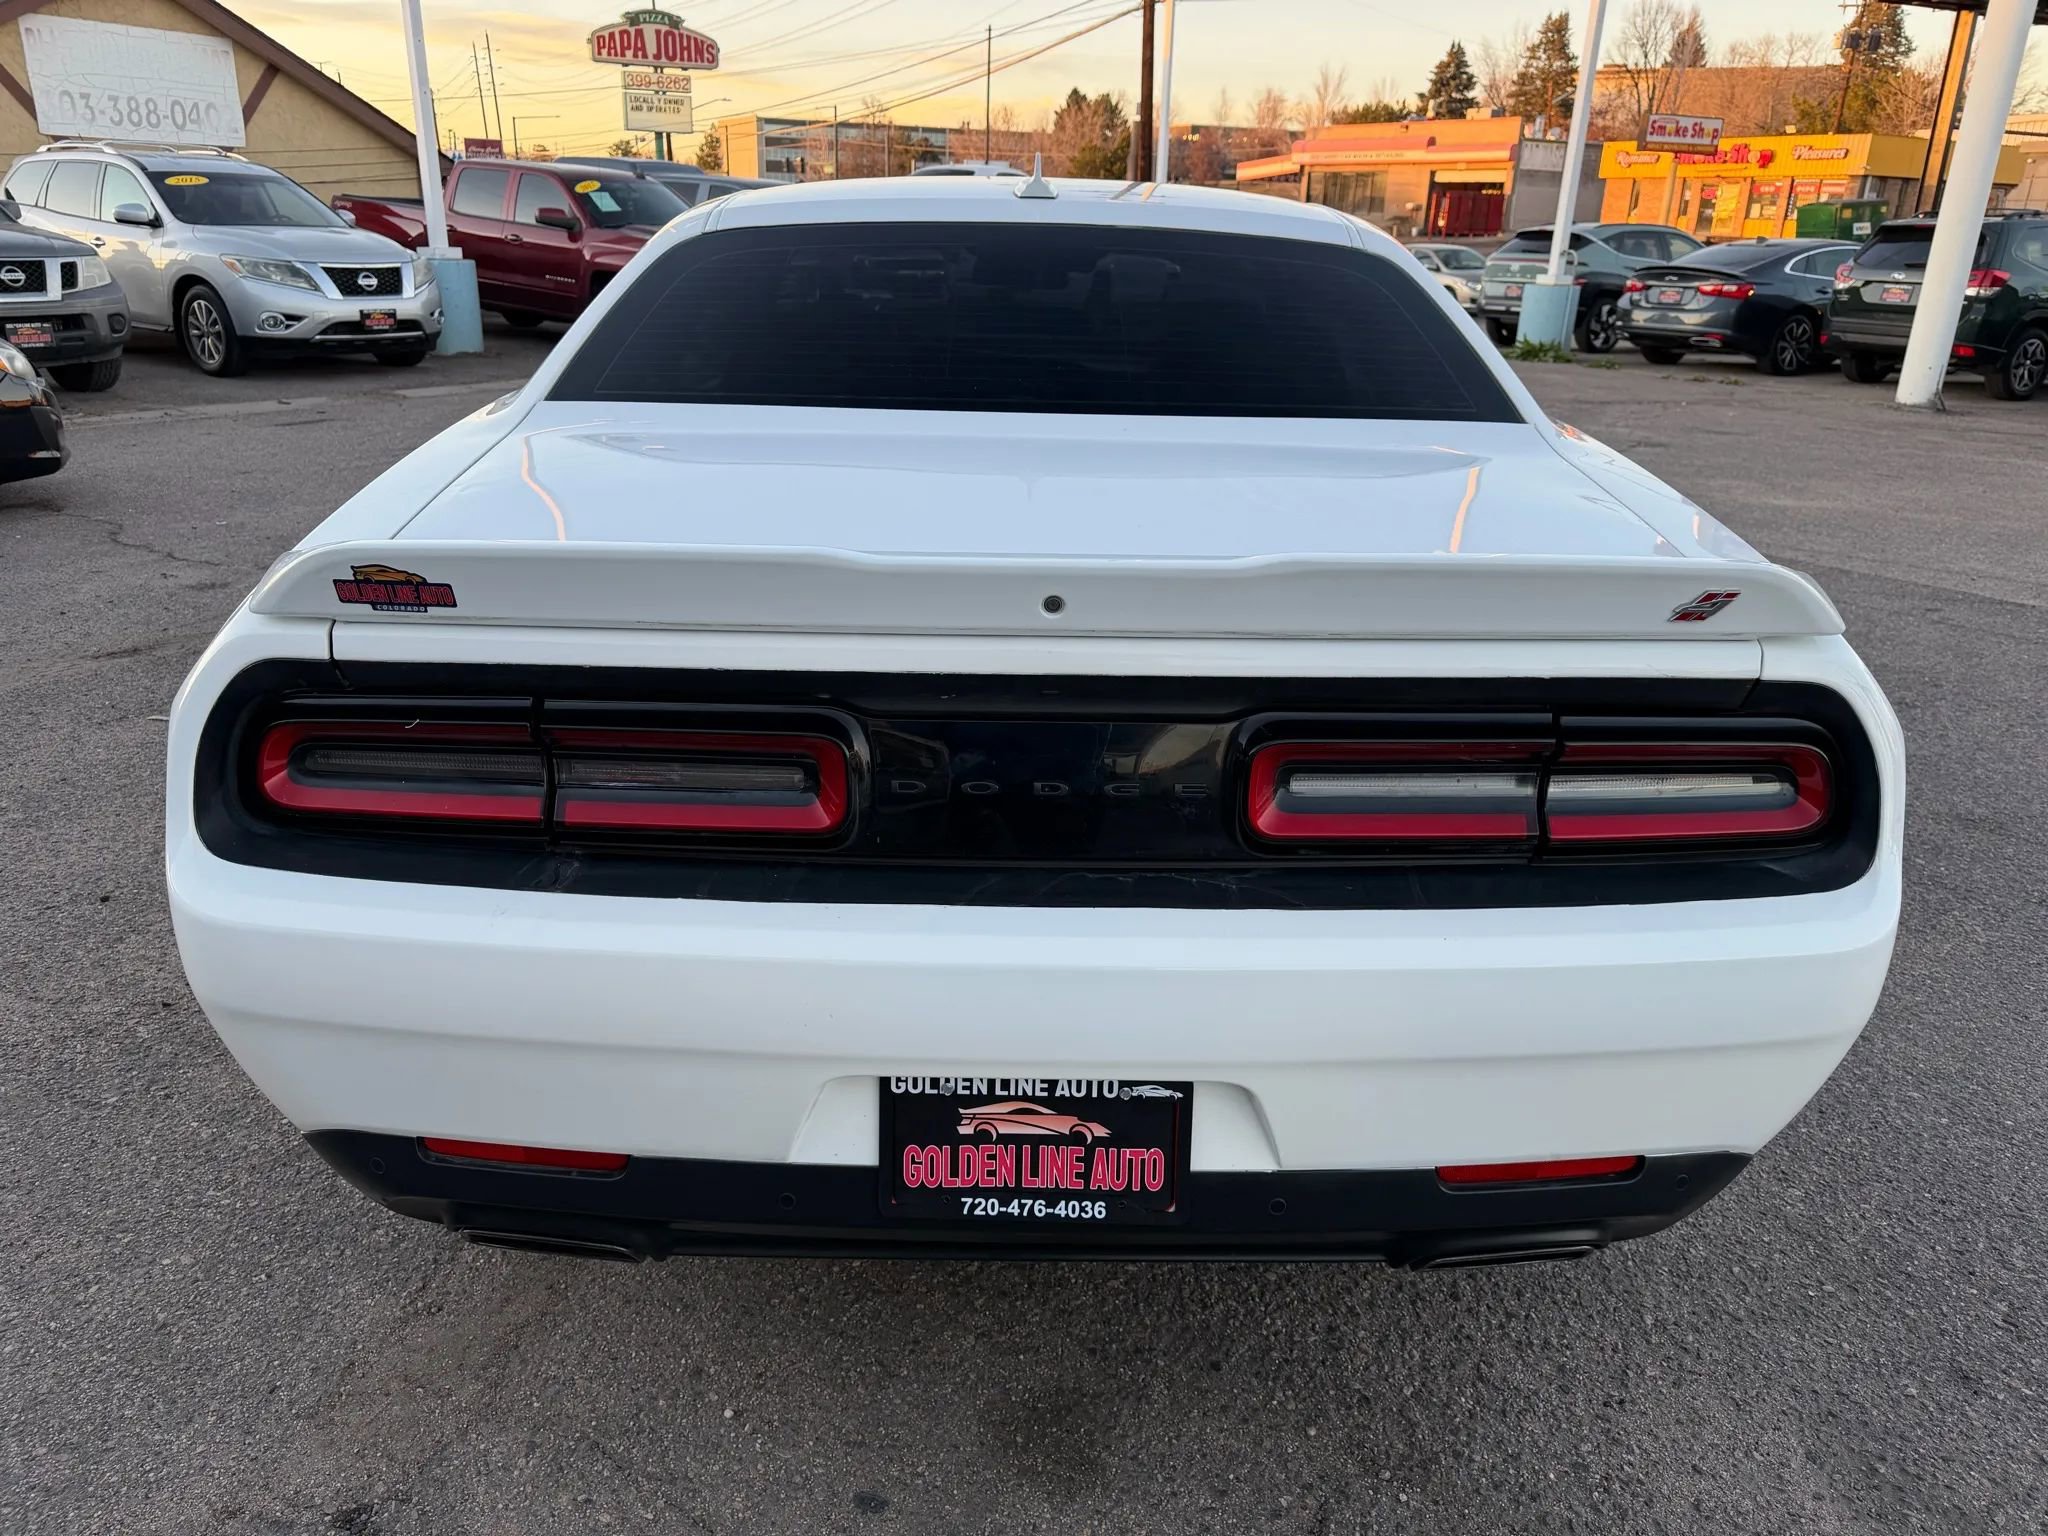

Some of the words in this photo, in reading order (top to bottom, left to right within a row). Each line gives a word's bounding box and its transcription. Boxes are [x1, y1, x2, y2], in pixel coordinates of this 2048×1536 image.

[639, 13, 670, 24] PIZZA
[596, 27, 649, 60] PAPA
[653, 28, 716, 65] JOHNS
[626, 73, 690, 91] 399-6262
[630, 104, 644, 113] AND
[646, 105, 681, 114] OPERATED
[663, 97, 685, 106] OWNED
[1649, 119, 1688, 138] Smoke
[1690, 121, 1720, 143] Shop
[1728, 143, 1774, 169] Shop
[1792, 145, 1849, 160] Pleasures
[336, 582, 388, 602] GOLDEN
[389, 584, 419, 604] LINE
[419, 586, 455, 606] AUTO
[376, 604, 426, 612] COLORADO
[891, 780, 1209, 799] DODGE
[890, 1076, 991, 1096] GOLDEN
[995, 1078, 1049, 1097] LINE
[1055, 1079, 1120, 1099] AUTO
[903, 1143, 1016, 1189] GOLDEN
[1021, 1144, 1085, 1190] LINE
[1090, 1147, 1165, 1192] AUTO
[961, 1196, 1107, 1219] 720-476-4036
